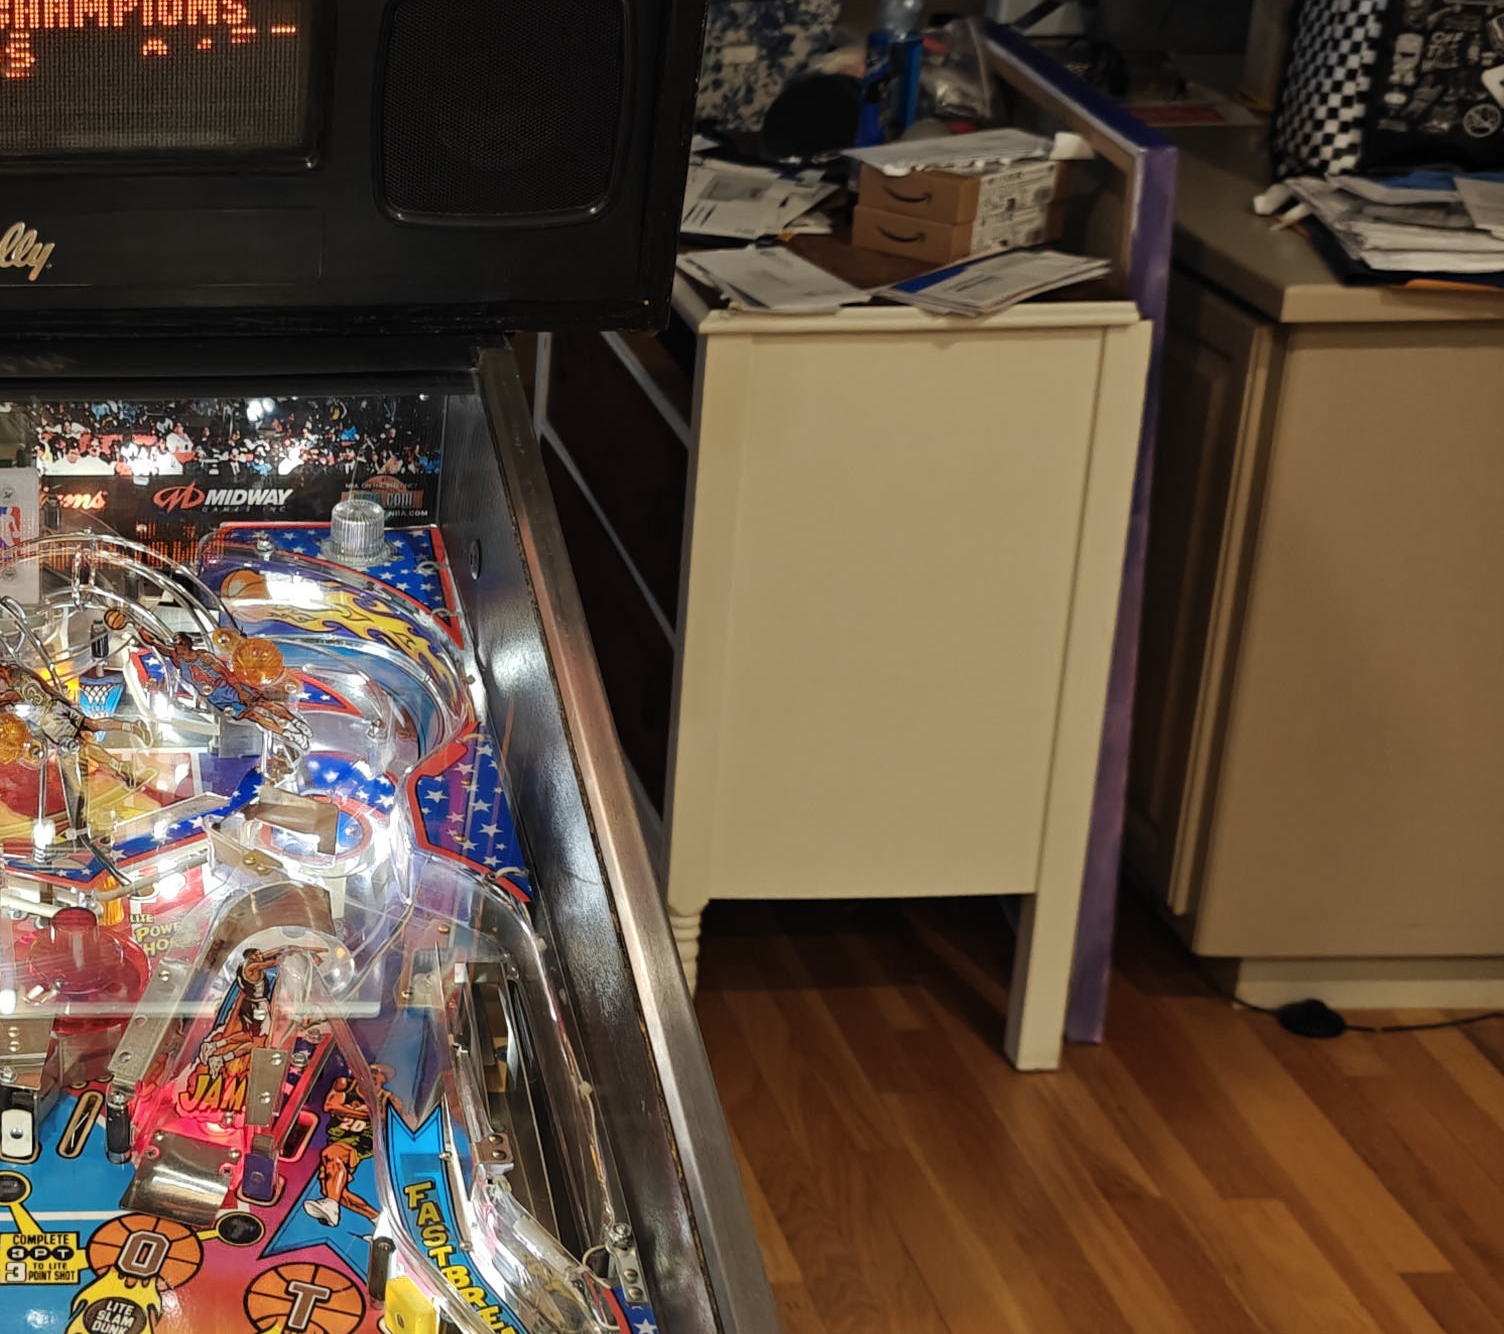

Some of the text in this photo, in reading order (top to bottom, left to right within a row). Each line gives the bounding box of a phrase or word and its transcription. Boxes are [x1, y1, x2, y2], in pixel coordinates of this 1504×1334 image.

[202, 487, 294, 509] MIDWAY
[341, 1116, 365, 1132] 20
[12, 1233, 70, 1246] COMPLETE
[32, 1261, 68, 1271] TO LITE
[105, 1300, 136, 1316] LITE
[98, 1310, 136, 1328] SLAM
